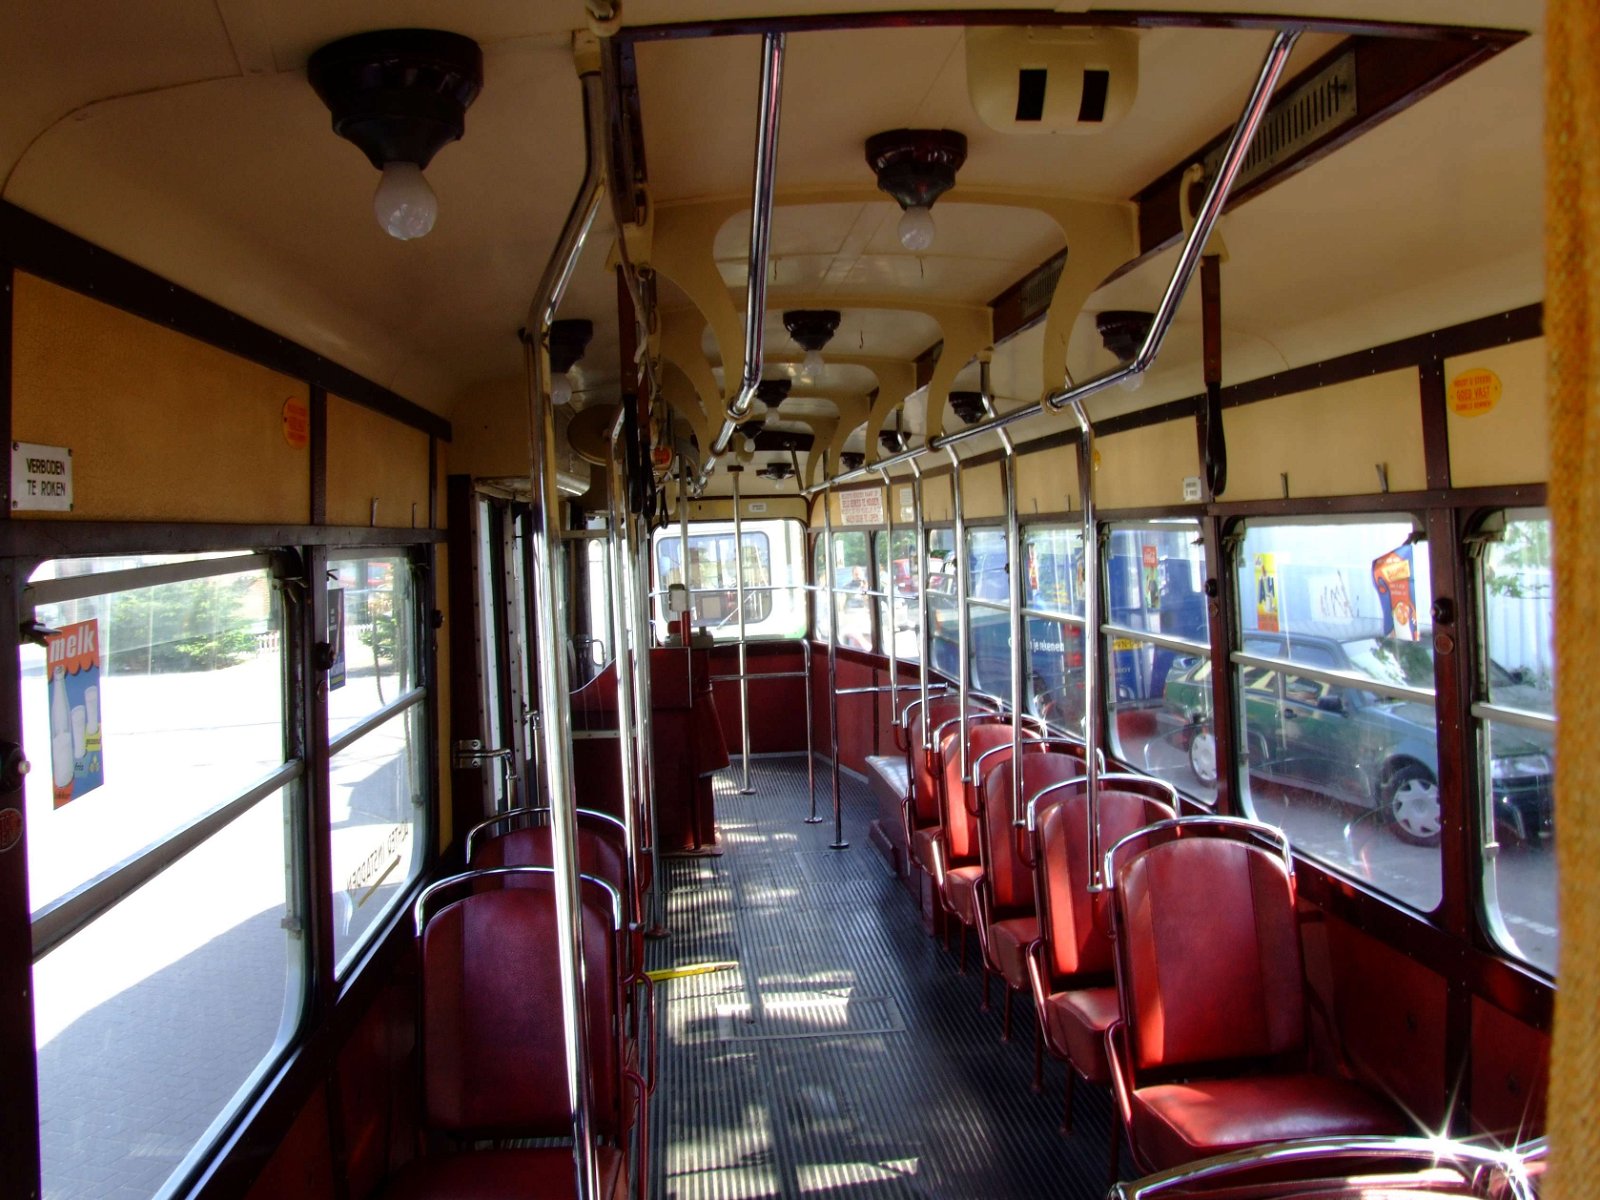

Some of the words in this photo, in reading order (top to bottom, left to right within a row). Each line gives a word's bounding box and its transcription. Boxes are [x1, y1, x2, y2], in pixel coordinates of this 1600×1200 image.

[26, 458, 66, 475] VERBODEN
[27, 479, 37, 495] TE
[41, 480, 66, 496] ROKEN
[49, 624, 95, 663] melk
